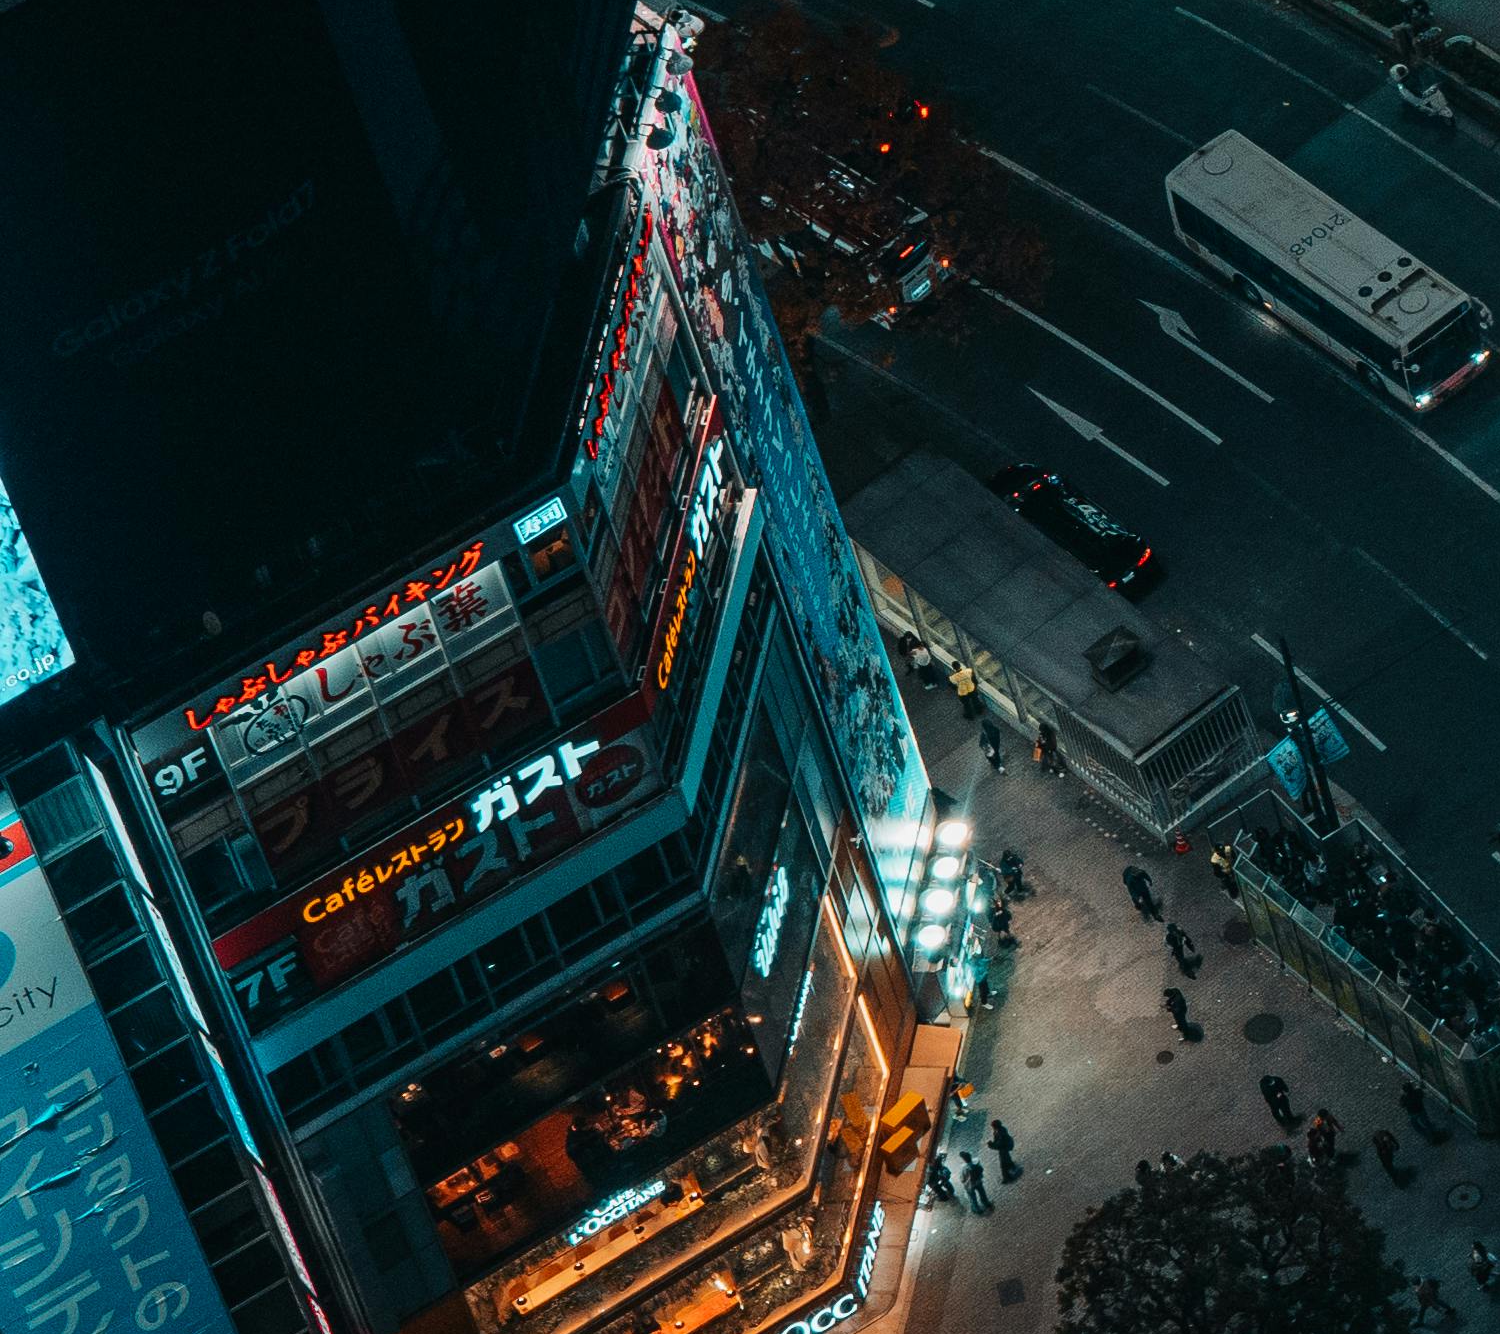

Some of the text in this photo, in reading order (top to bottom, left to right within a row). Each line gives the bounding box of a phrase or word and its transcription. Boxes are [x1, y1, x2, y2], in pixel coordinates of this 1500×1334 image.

[1288, 211, 1350, 258] 21048
[518, 503, 565, 539] 寿司
[184, 540, 486, 731] しゃぶしゃぶバイキング
[154, 745, 209, 797] 9F
[469, 738, 603, 834] ガスト
[234, 949, 300, 1010] 7F
[44, 1066, 191, 1333] コンタクトの
